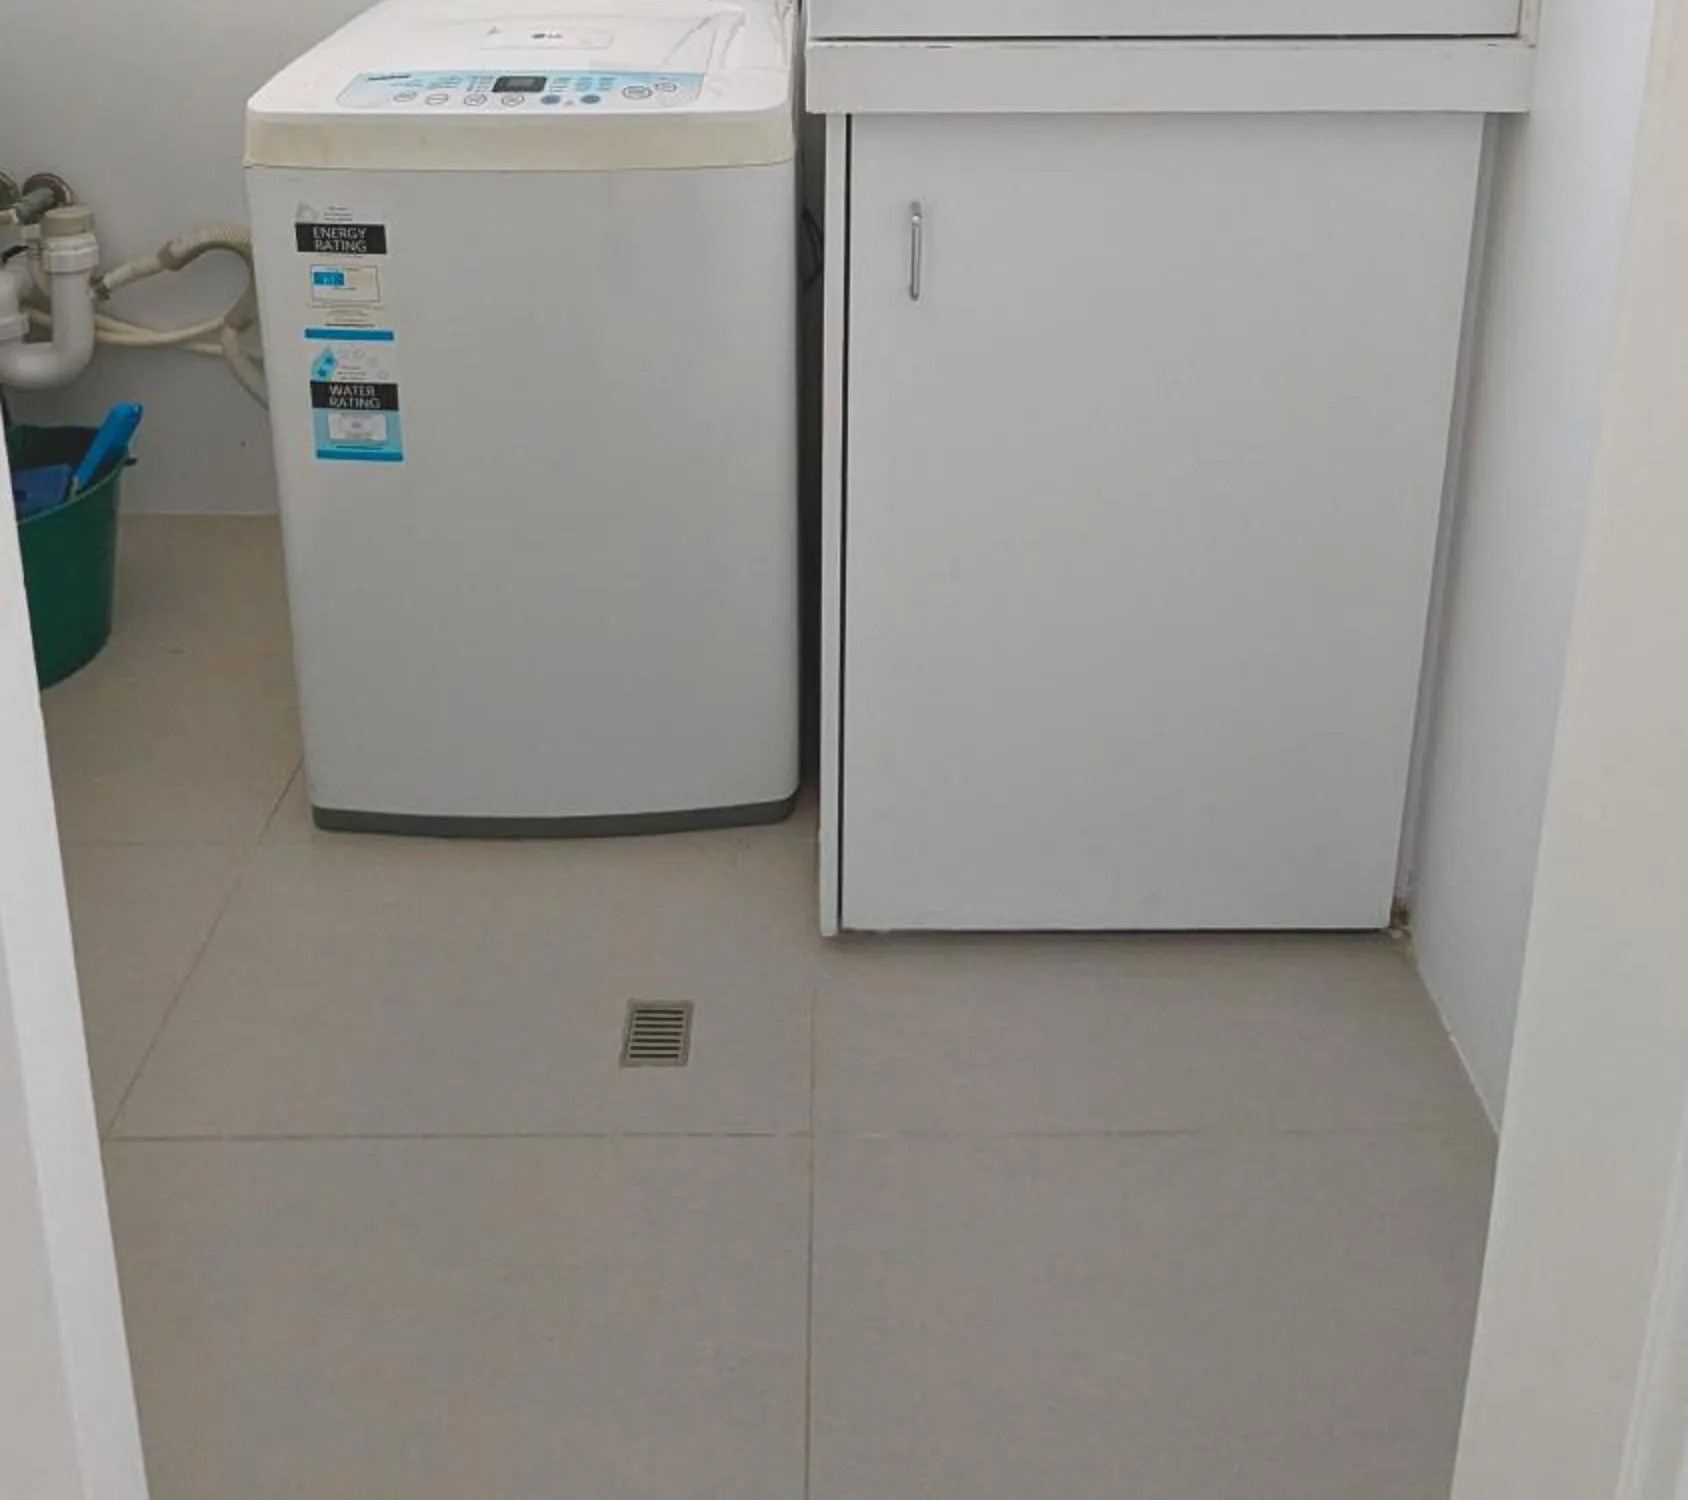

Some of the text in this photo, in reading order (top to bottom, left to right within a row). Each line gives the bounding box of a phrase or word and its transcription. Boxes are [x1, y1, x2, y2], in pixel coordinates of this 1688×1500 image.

[313, 227, 368, 240] ENERGY
[315, 239, 368, 253] RATING
[329, 384, 375, 397] WATER
[329, 397, 381, 409] RATING
